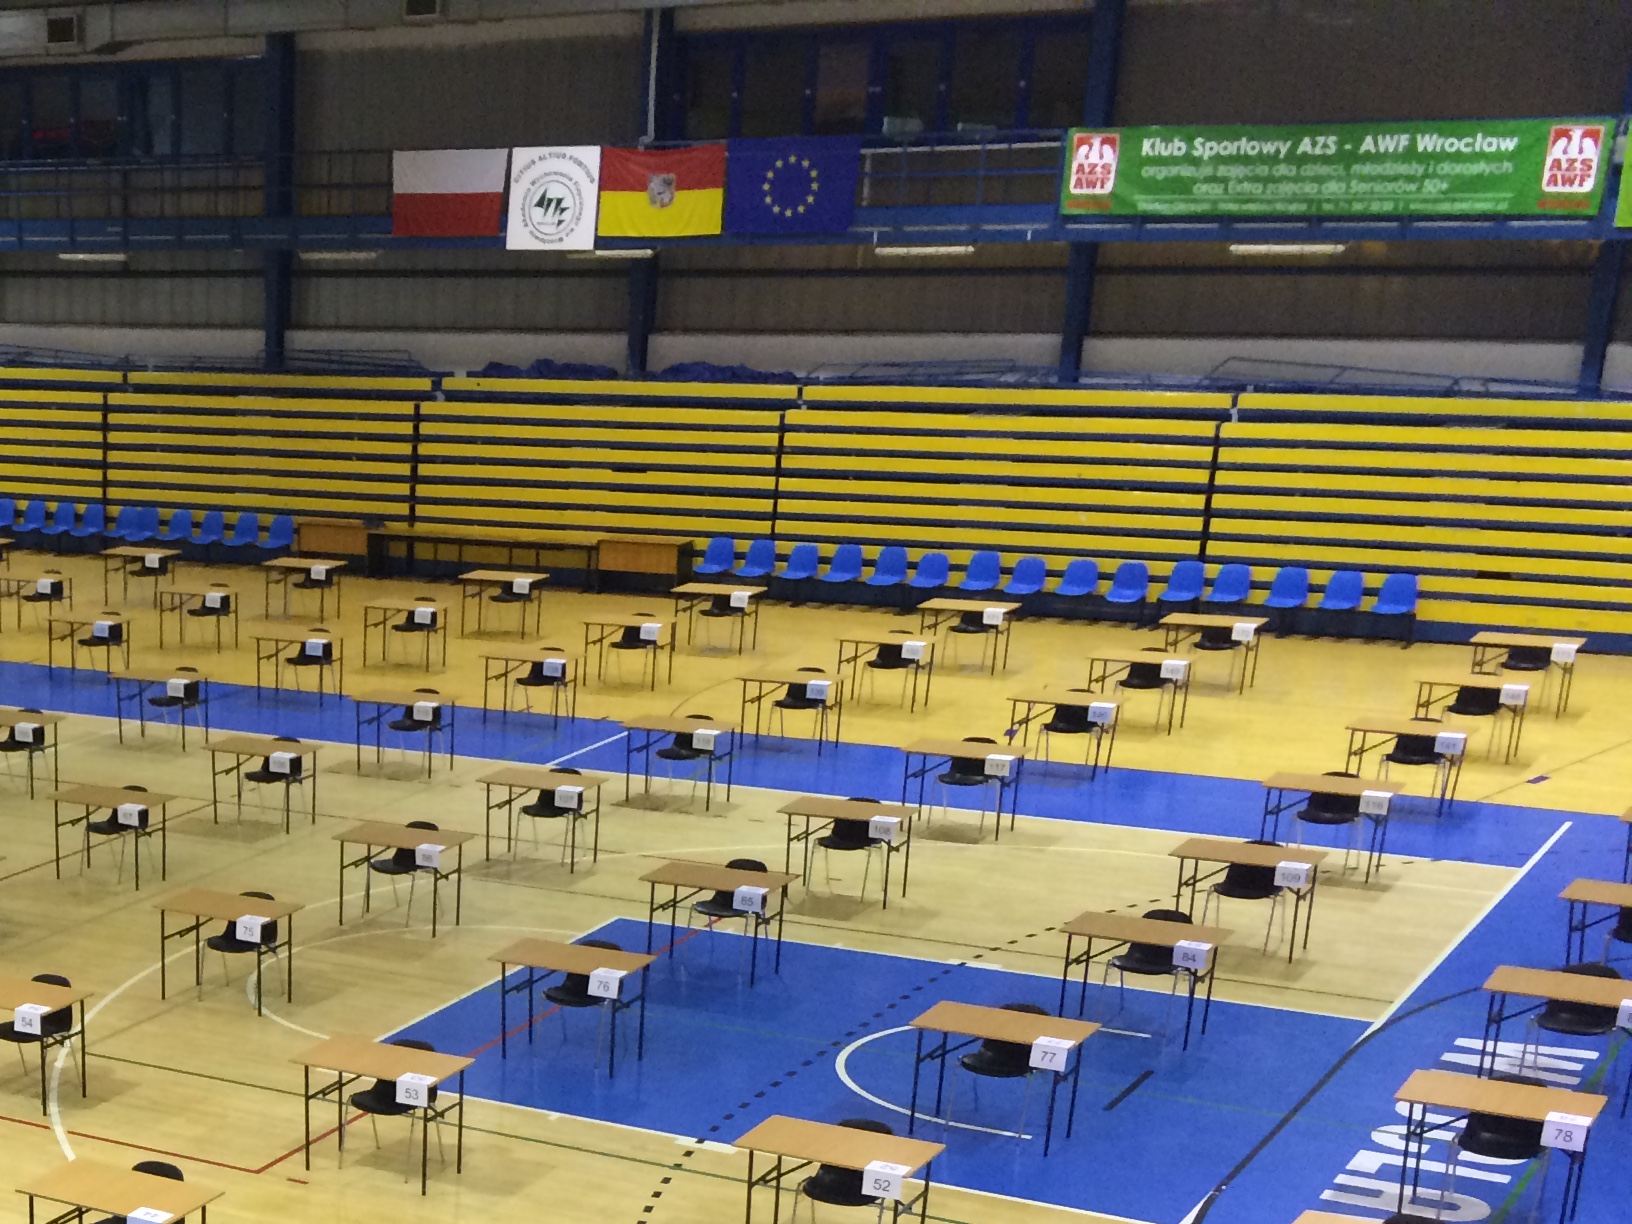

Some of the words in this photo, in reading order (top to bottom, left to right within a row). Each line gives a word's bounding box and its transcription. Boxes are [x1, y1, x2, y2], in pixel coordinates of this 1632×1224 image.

[1141, 137, 1186, 156] Klub
[1192, 137, 1292, 160] Sportowy
[1297, 136, 1337, 155] AZS
[1360, 134, 1410, 153] AWF
[1076, 163, 1112, 175] AZS
[1549, 158, 1593, 172] AZS
[1074, 177, 1110, 189] AWF
[1546, 174, 1591, 187] AWF
[875, 826, 891, 835] 108
[1281, 873, 1301, 882] 109
[741, 896, 754, 906] 85
[243, 926, 253, 936] 75
[1182, 953, 1196, 962] 84
[598, 981, 609, 992] 76
[22, 1017, 33, 1027] 54
[1041, 1051, 1056, 1063] 77
[405, 1088, 419, 1100] 53
[1555, 1129, 1573, 1142] 78
[873, 1179, 890, 1192] 52
